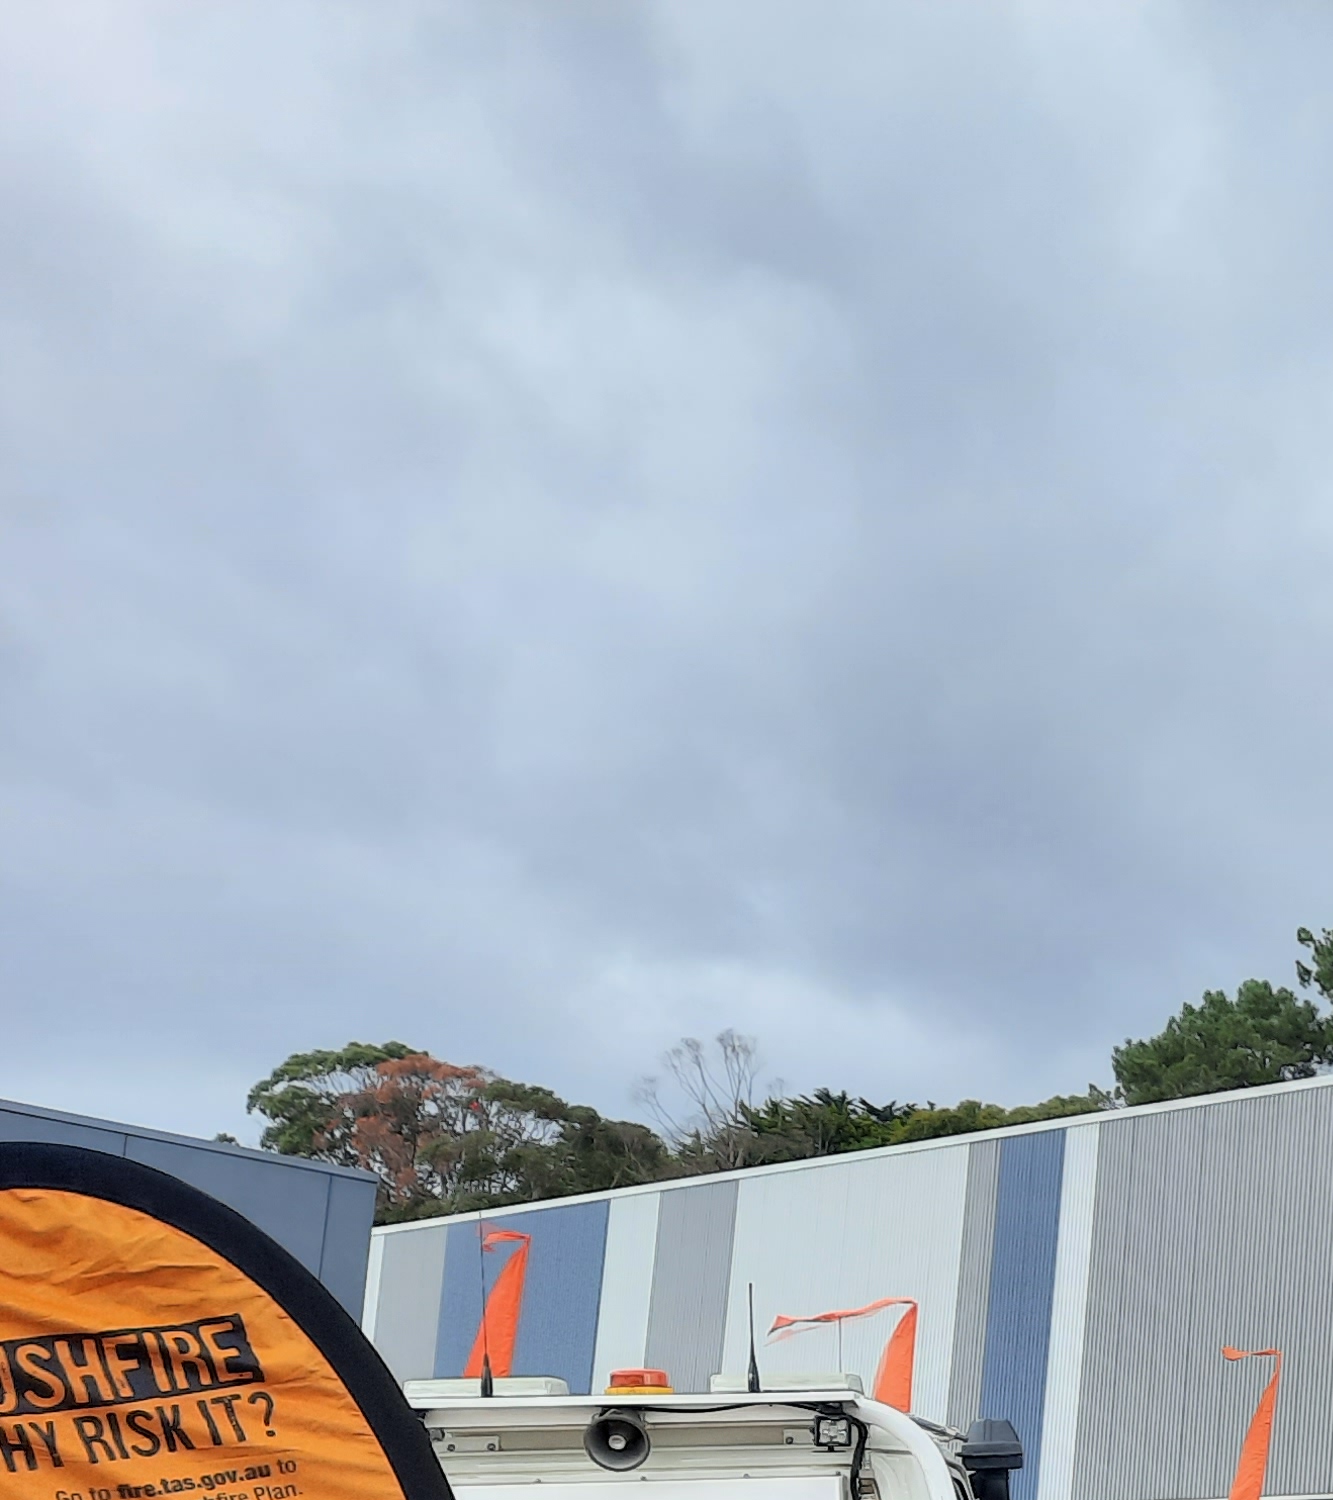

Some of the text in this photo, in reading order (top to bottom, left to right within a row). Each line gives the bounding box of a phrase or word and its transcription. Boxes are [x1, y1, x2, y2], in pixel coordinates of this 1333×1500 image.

[0, 1391, 276, 1473] HY RISK IT?
[116, 1464, 272, 1500] fire.tas.gov.au
[278, 1458, 298, 1475] to
